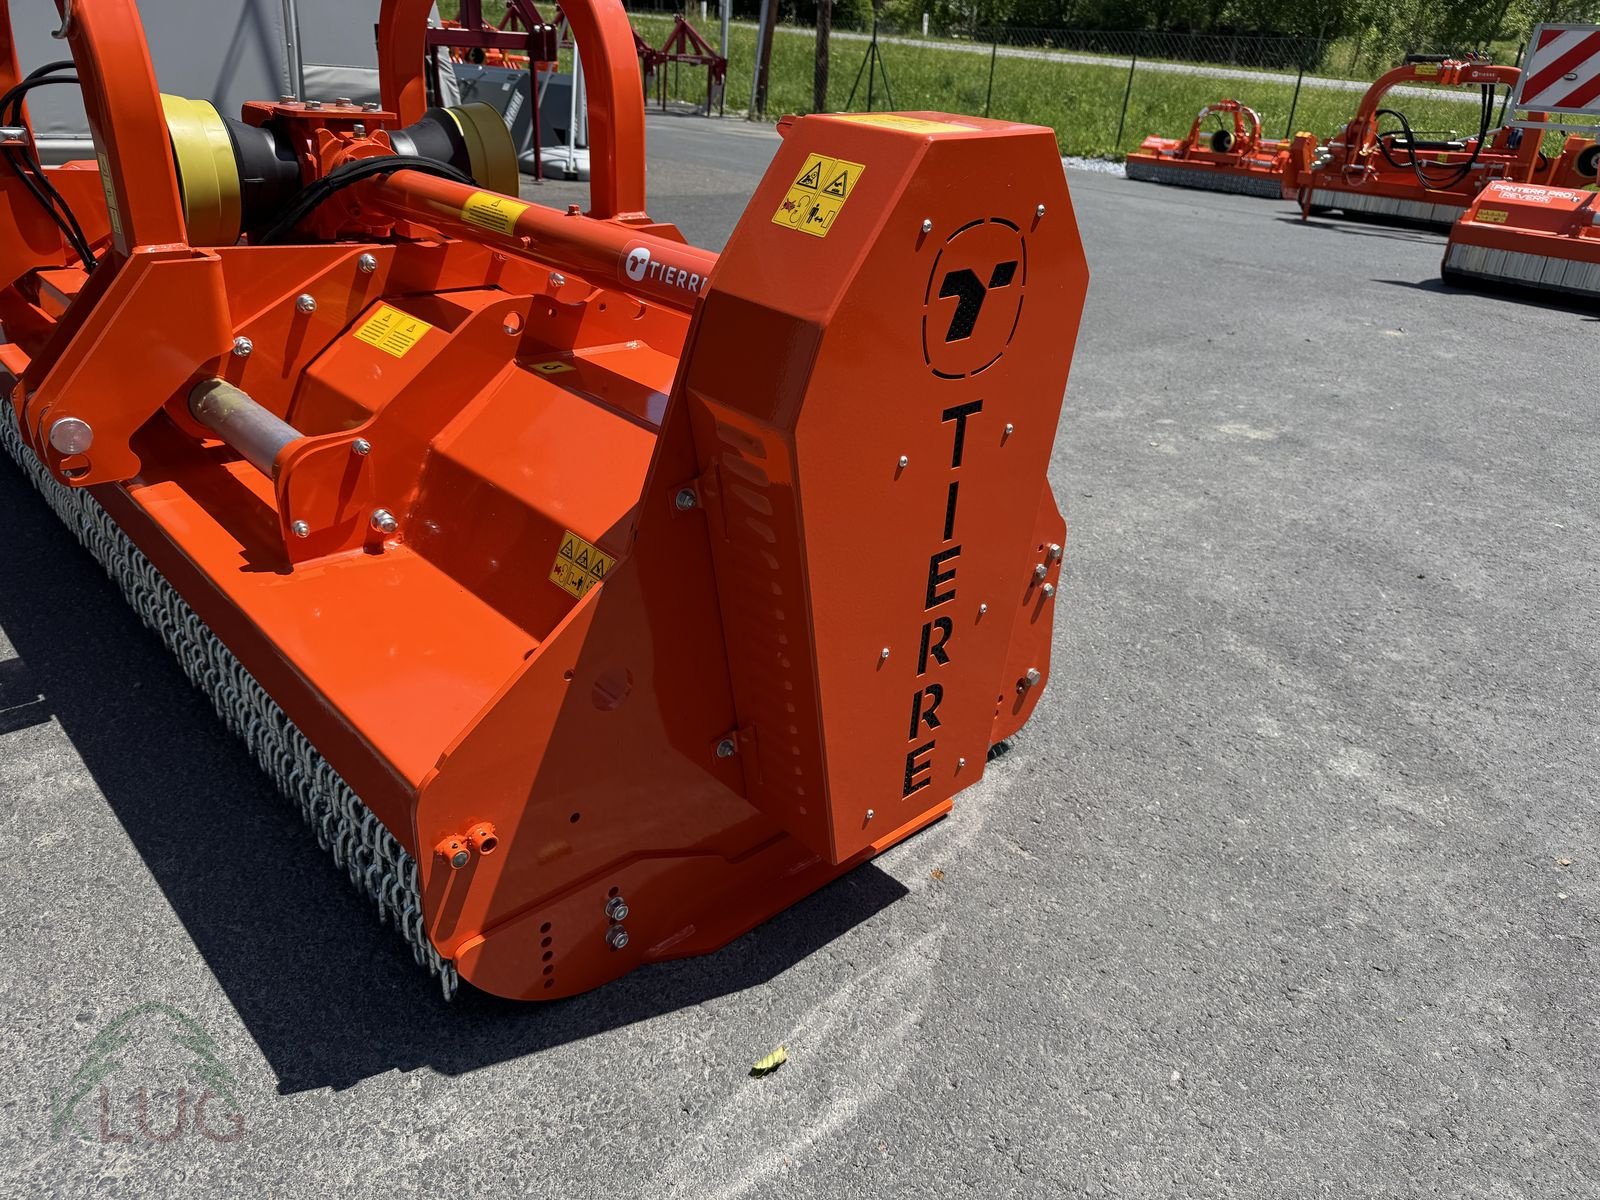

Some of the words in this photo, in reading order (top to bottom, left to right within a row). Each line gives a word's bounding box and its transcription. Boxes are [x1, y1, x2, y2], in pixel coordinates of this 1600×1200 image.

[1493, 184, 1546, 196] PANTERA
[1547, 190, 1573, 199] PRO
[901, 399, 984, 801] TIERRE
